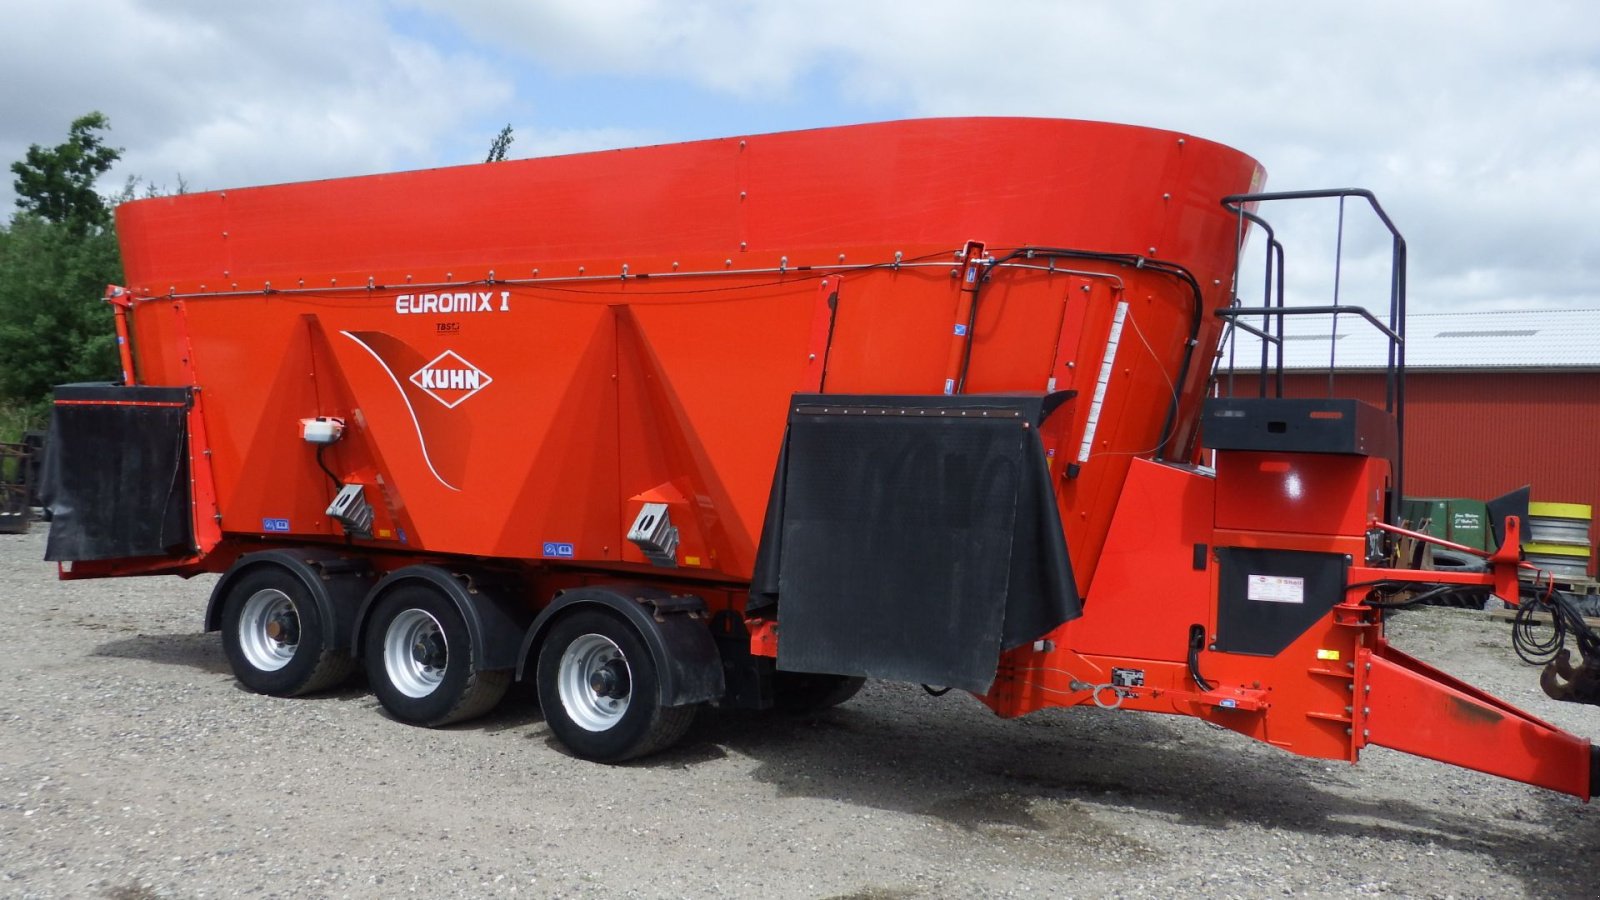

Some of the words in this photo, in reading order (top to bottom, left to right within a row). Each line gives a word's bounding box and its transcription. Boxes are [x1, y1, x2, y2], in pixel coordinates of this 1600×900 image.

[395, 292, 493, 313] EUROMIX
[499, 291, 510, 311] I
[421, 369, 480, 390] KUHN
